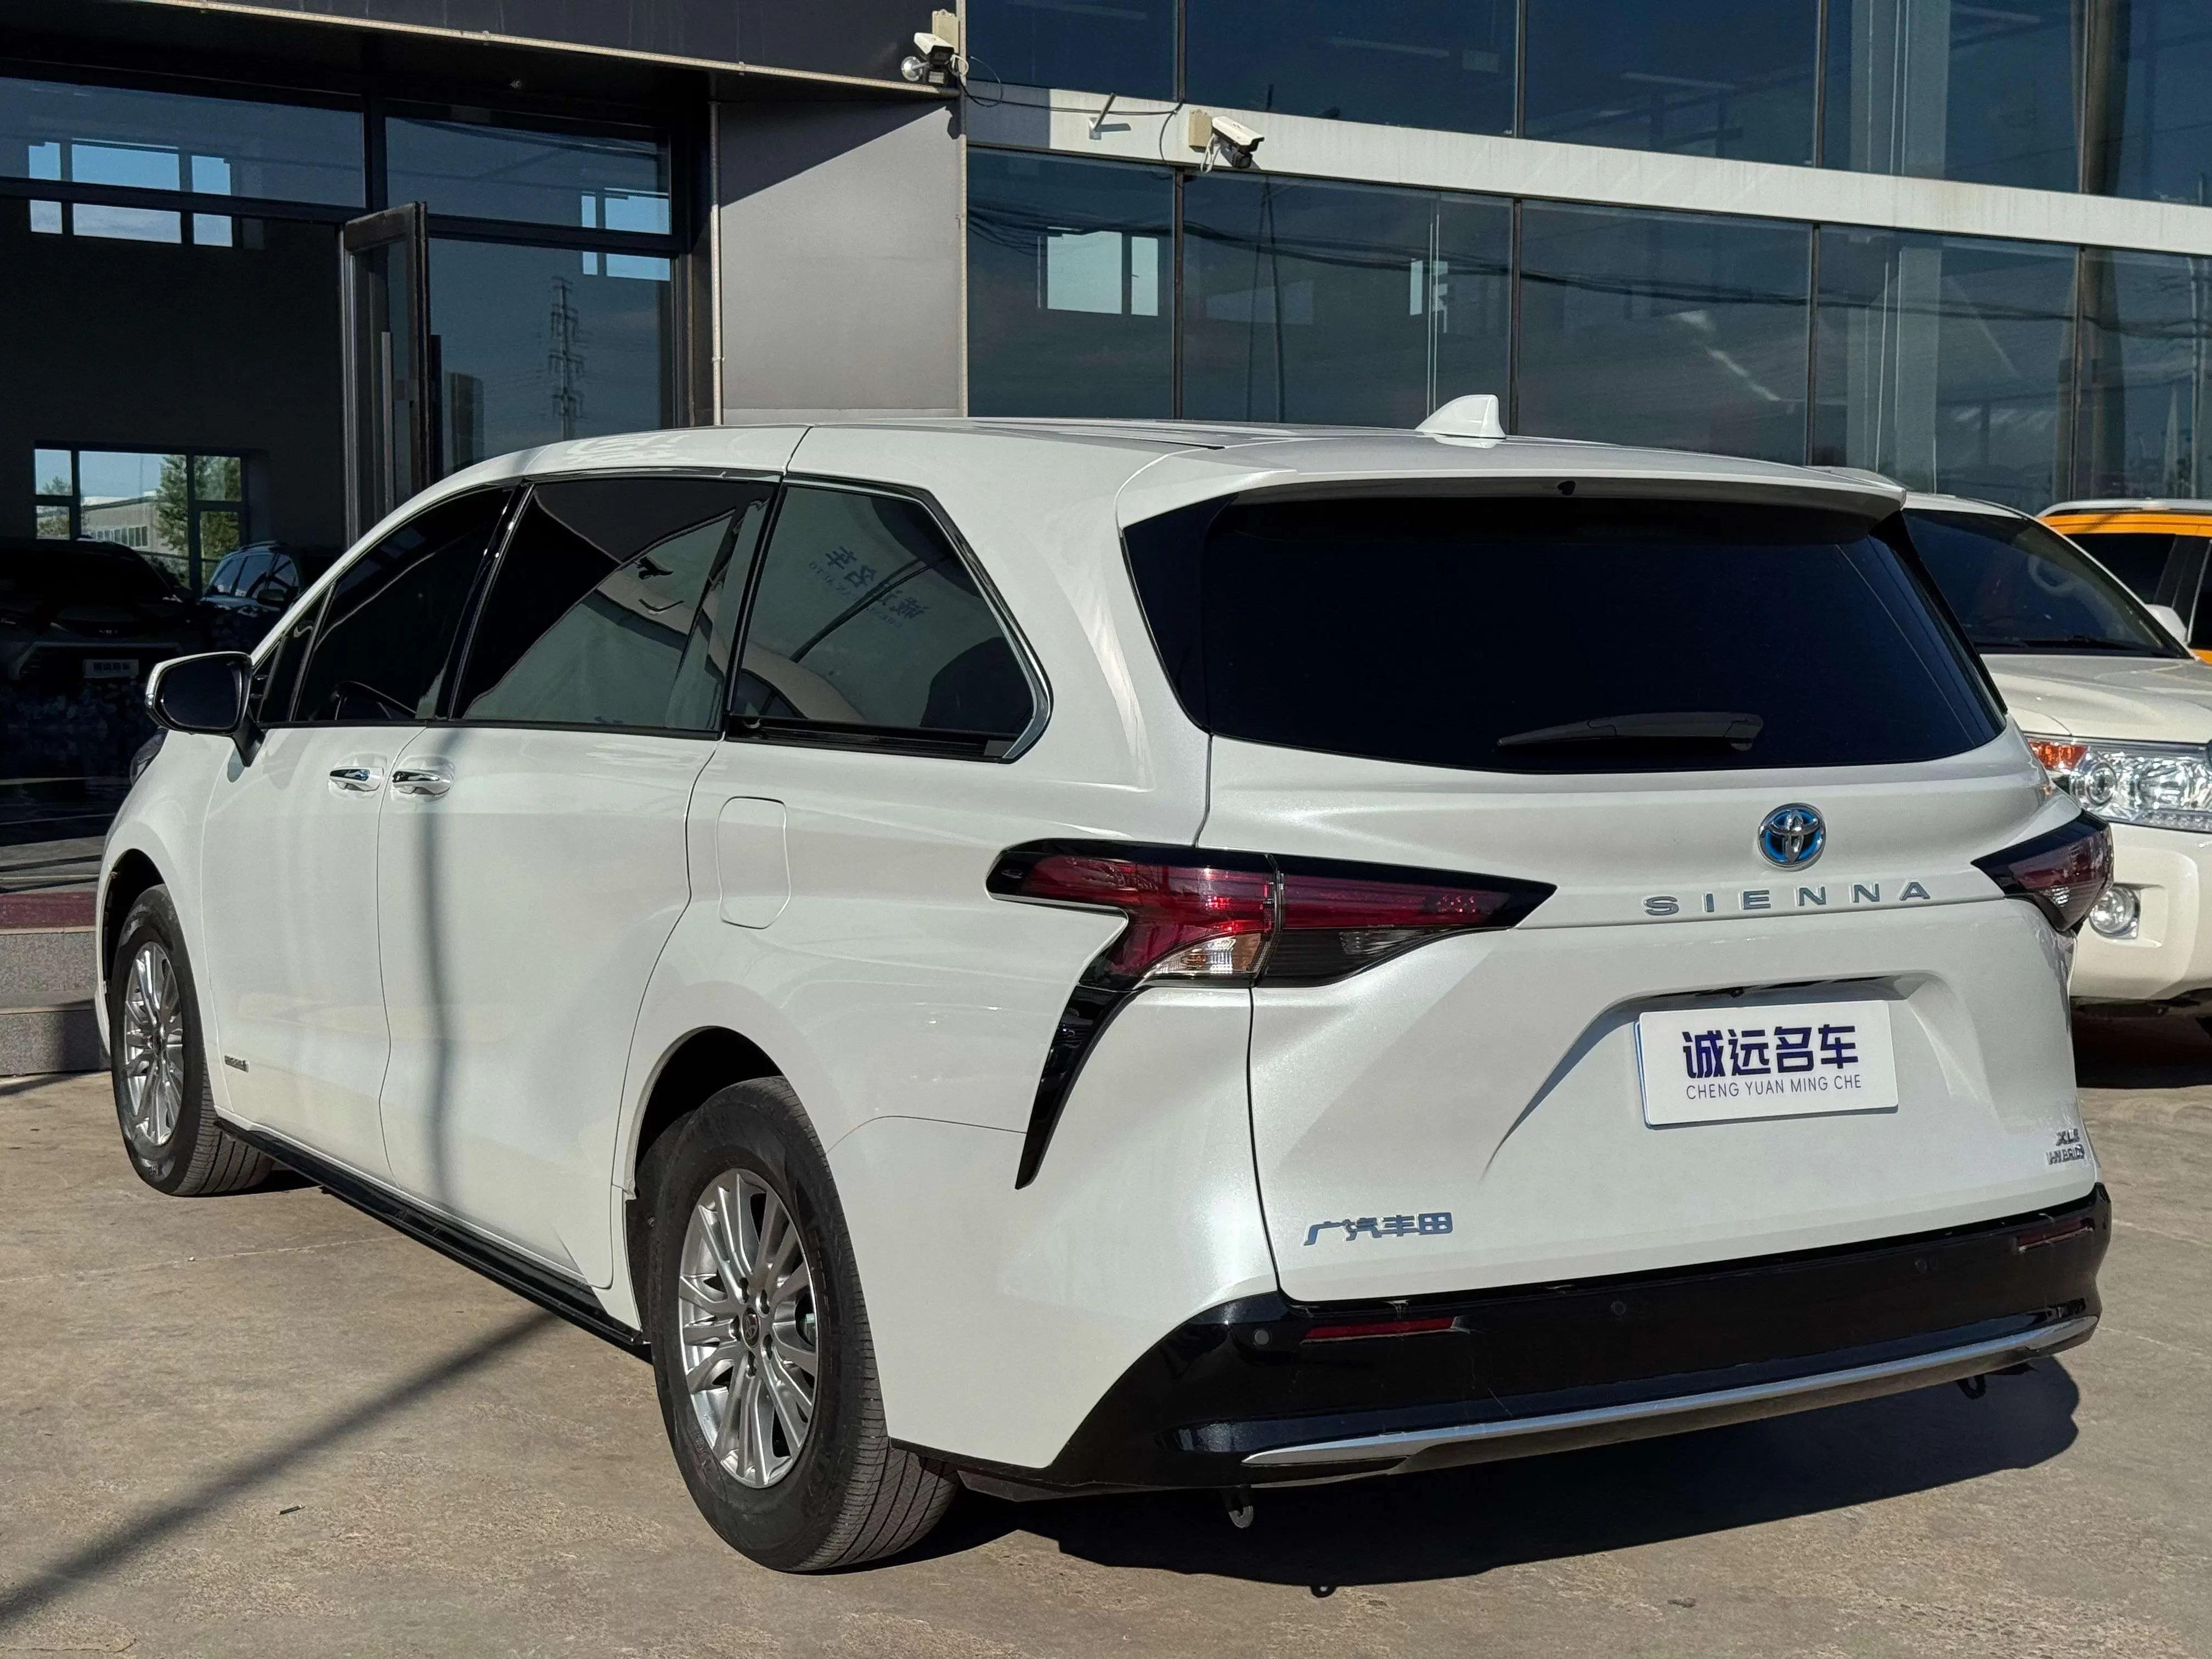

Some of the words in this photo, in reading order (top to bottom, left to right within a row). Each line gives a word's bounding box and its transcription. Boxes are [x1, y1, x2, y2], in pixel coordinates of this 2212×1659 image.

[1644, 882, 1931, 916] SIENNA
[1682, 1024, 1859, 1079] 诚远名车
[1686, 1082, 1740, 1100] CHENG
[1745, 1079, 1785, 1097] YUAN
[1790, 1076, 1829, 1093] MING
[1834, 1074, 1862, 1090] CHE
[1303, 1212, 1453, 1246] 广汽丰田
